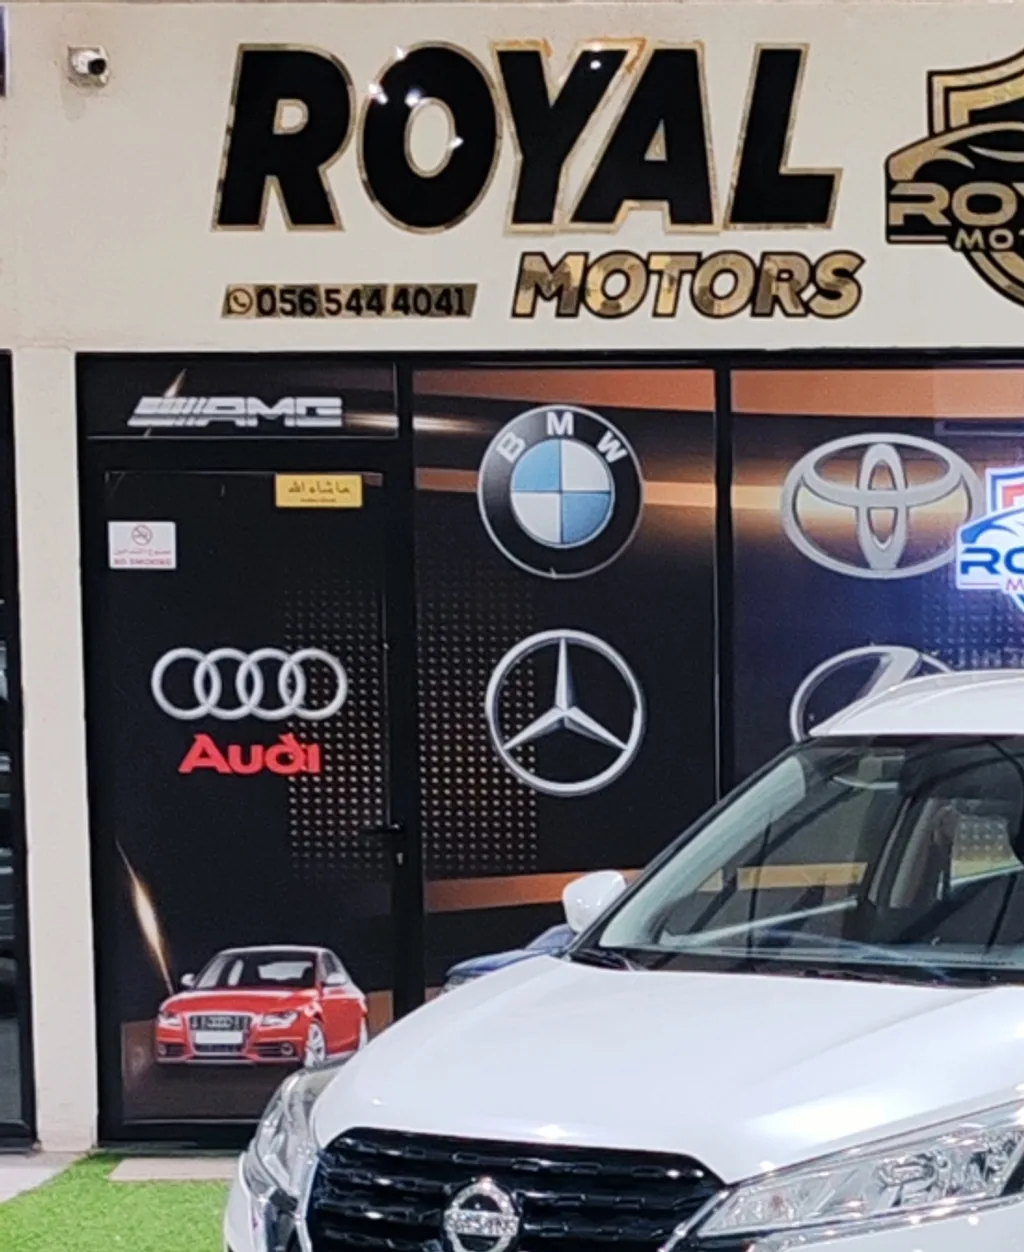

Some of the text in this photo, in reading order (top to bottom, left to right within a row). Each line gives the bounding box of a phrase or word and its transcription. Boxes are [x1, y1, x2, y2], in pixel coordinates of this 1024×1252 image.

[210, 38, 843, 234] ROYAL
[257, 287, 467, 316] 056 544 4041
[511, 251, 865, 319] MOTORS
[196, 396, 343, 427] AMG
[497, 411, 627, 463] BMW
[178, 734, 321, 774] Audi
